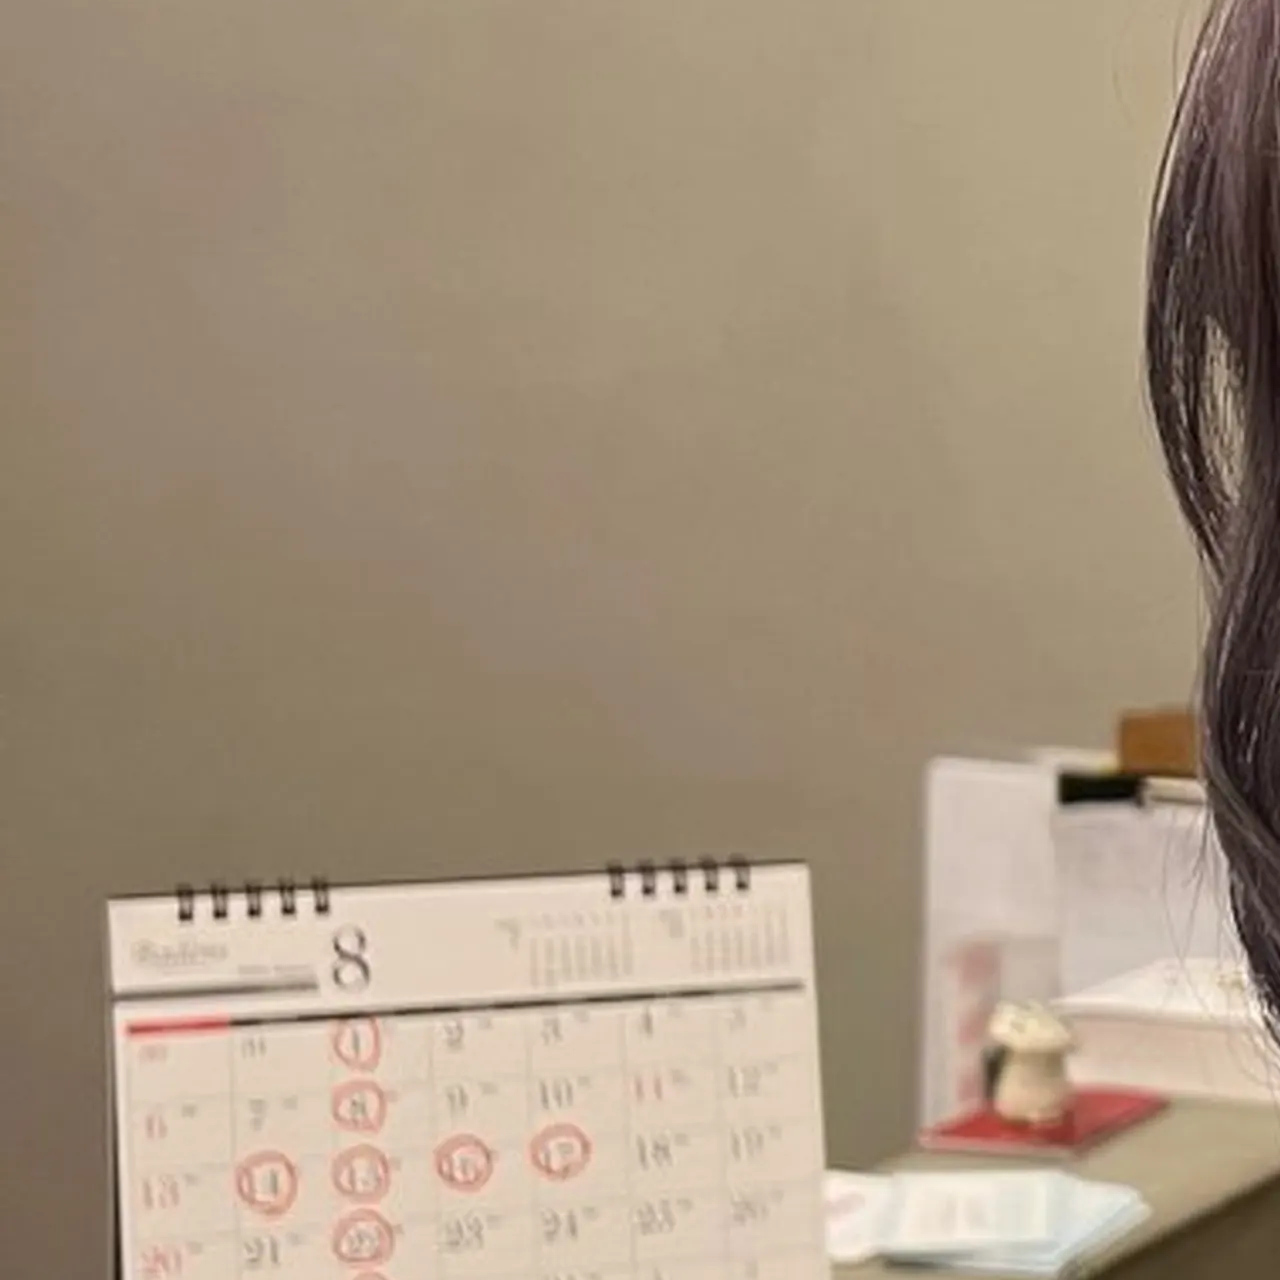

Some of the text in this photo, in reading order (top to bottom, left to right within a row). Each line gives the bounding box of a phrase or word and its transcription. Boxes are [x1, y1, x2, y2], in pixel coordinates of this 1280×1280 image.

[332, 925, 371, 993] 8
[539, 1079, 574, 1110] 10
[636, 1131, 674, 1169] 18
[243, 1236, 280, 1269] 21
